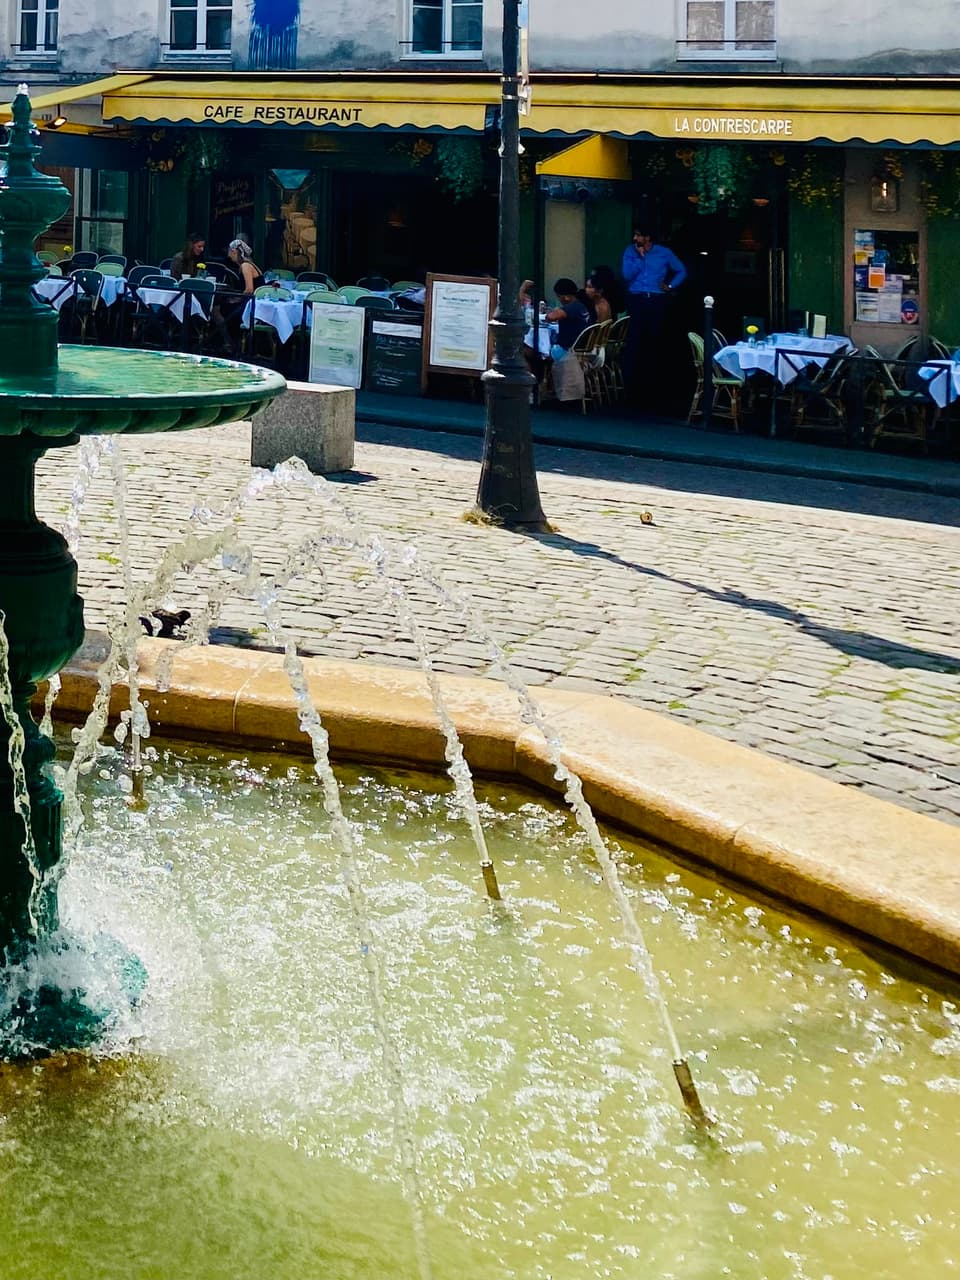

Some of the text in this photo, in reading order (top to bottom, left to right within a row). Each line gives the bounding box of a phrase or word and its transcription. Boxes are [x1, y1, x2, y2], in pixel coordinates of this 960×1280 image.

[204, 105, 363, 121] CAFE RESTAURANT
[674, 117, 793, 135] LA CONTRESCARPE
